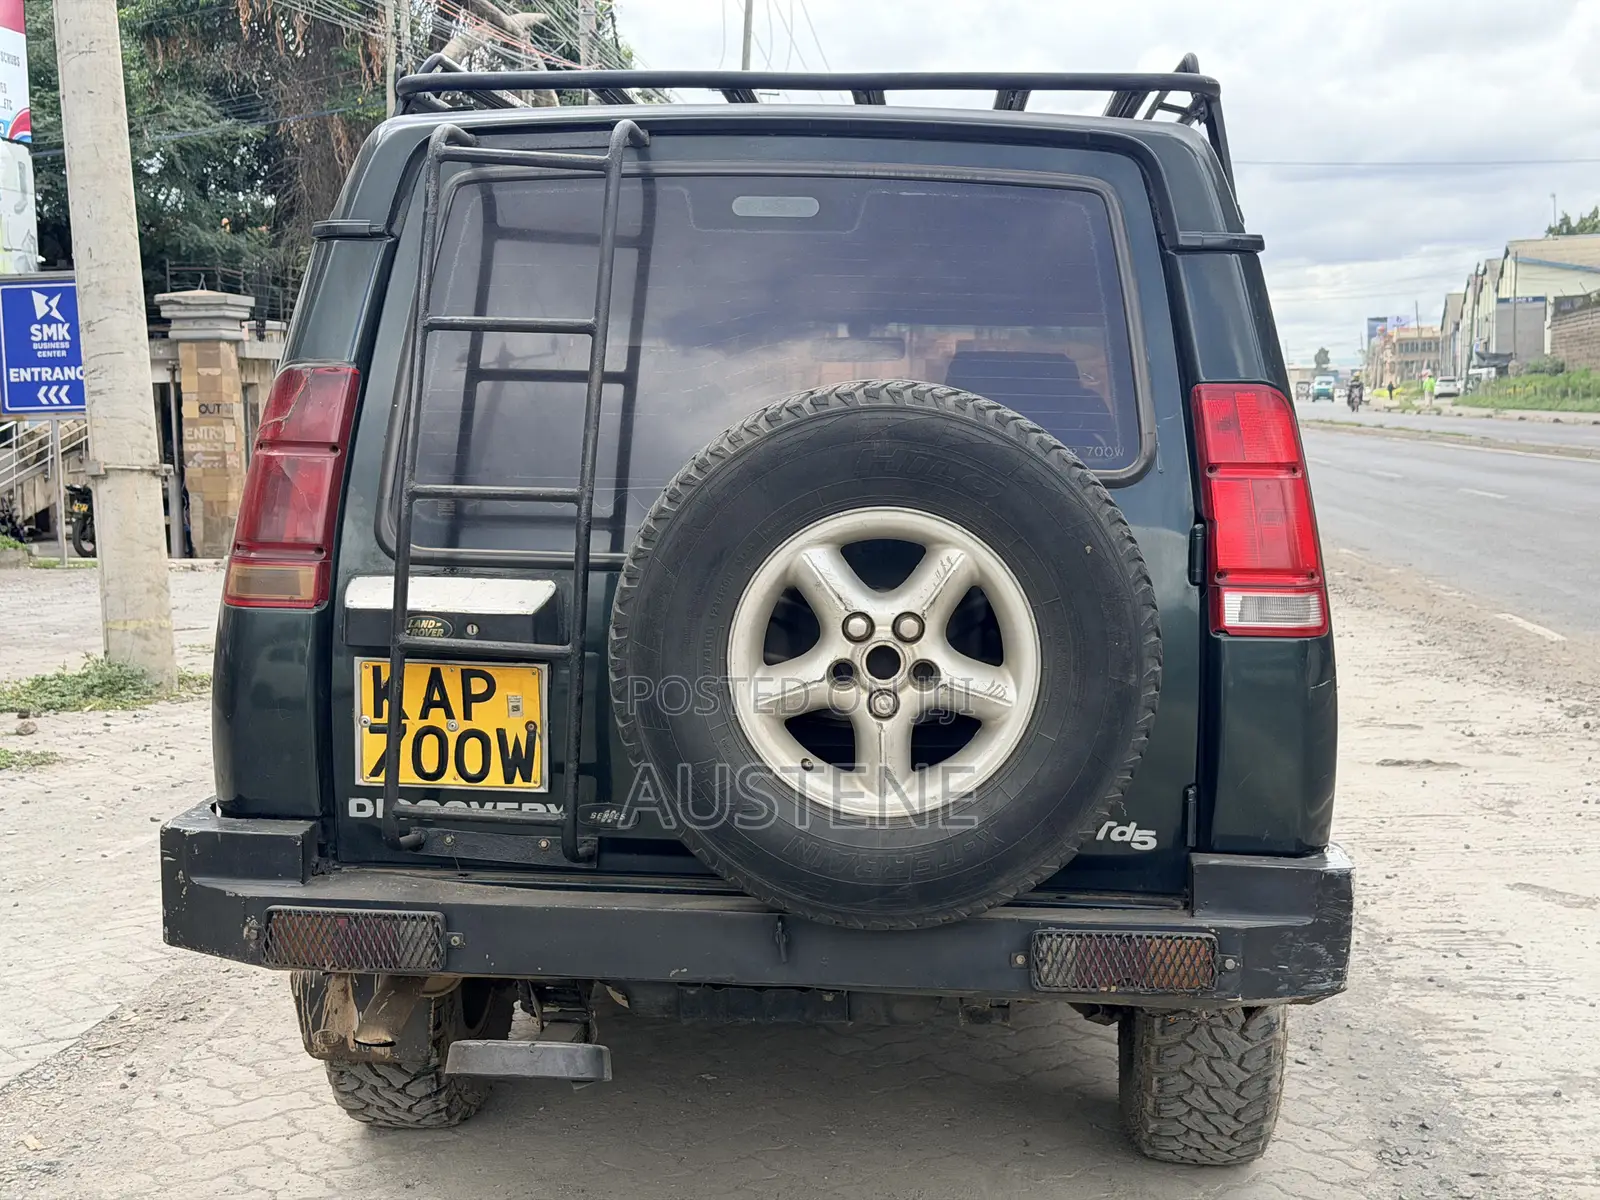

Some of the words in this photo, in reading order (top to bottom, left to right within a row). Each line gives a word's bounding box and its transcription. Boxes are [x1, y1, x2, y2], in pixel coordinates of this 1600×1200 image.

[30, 323, 71, 341] SMK
[33, 341, 70, 350] BUSINESS
[37, 350, 67, 358] CENTER
[9, 366, 85, 382] ENTRANC
[199, 403, 222, 414] OUT
[1086, 447, 1125, 457] 700W
[408, 620, 436, 628] LAND
[410, 628, 445, 637] ROVER
[372, 665, 497, 721] KAP
[369, 723, 537, 785] 700W
